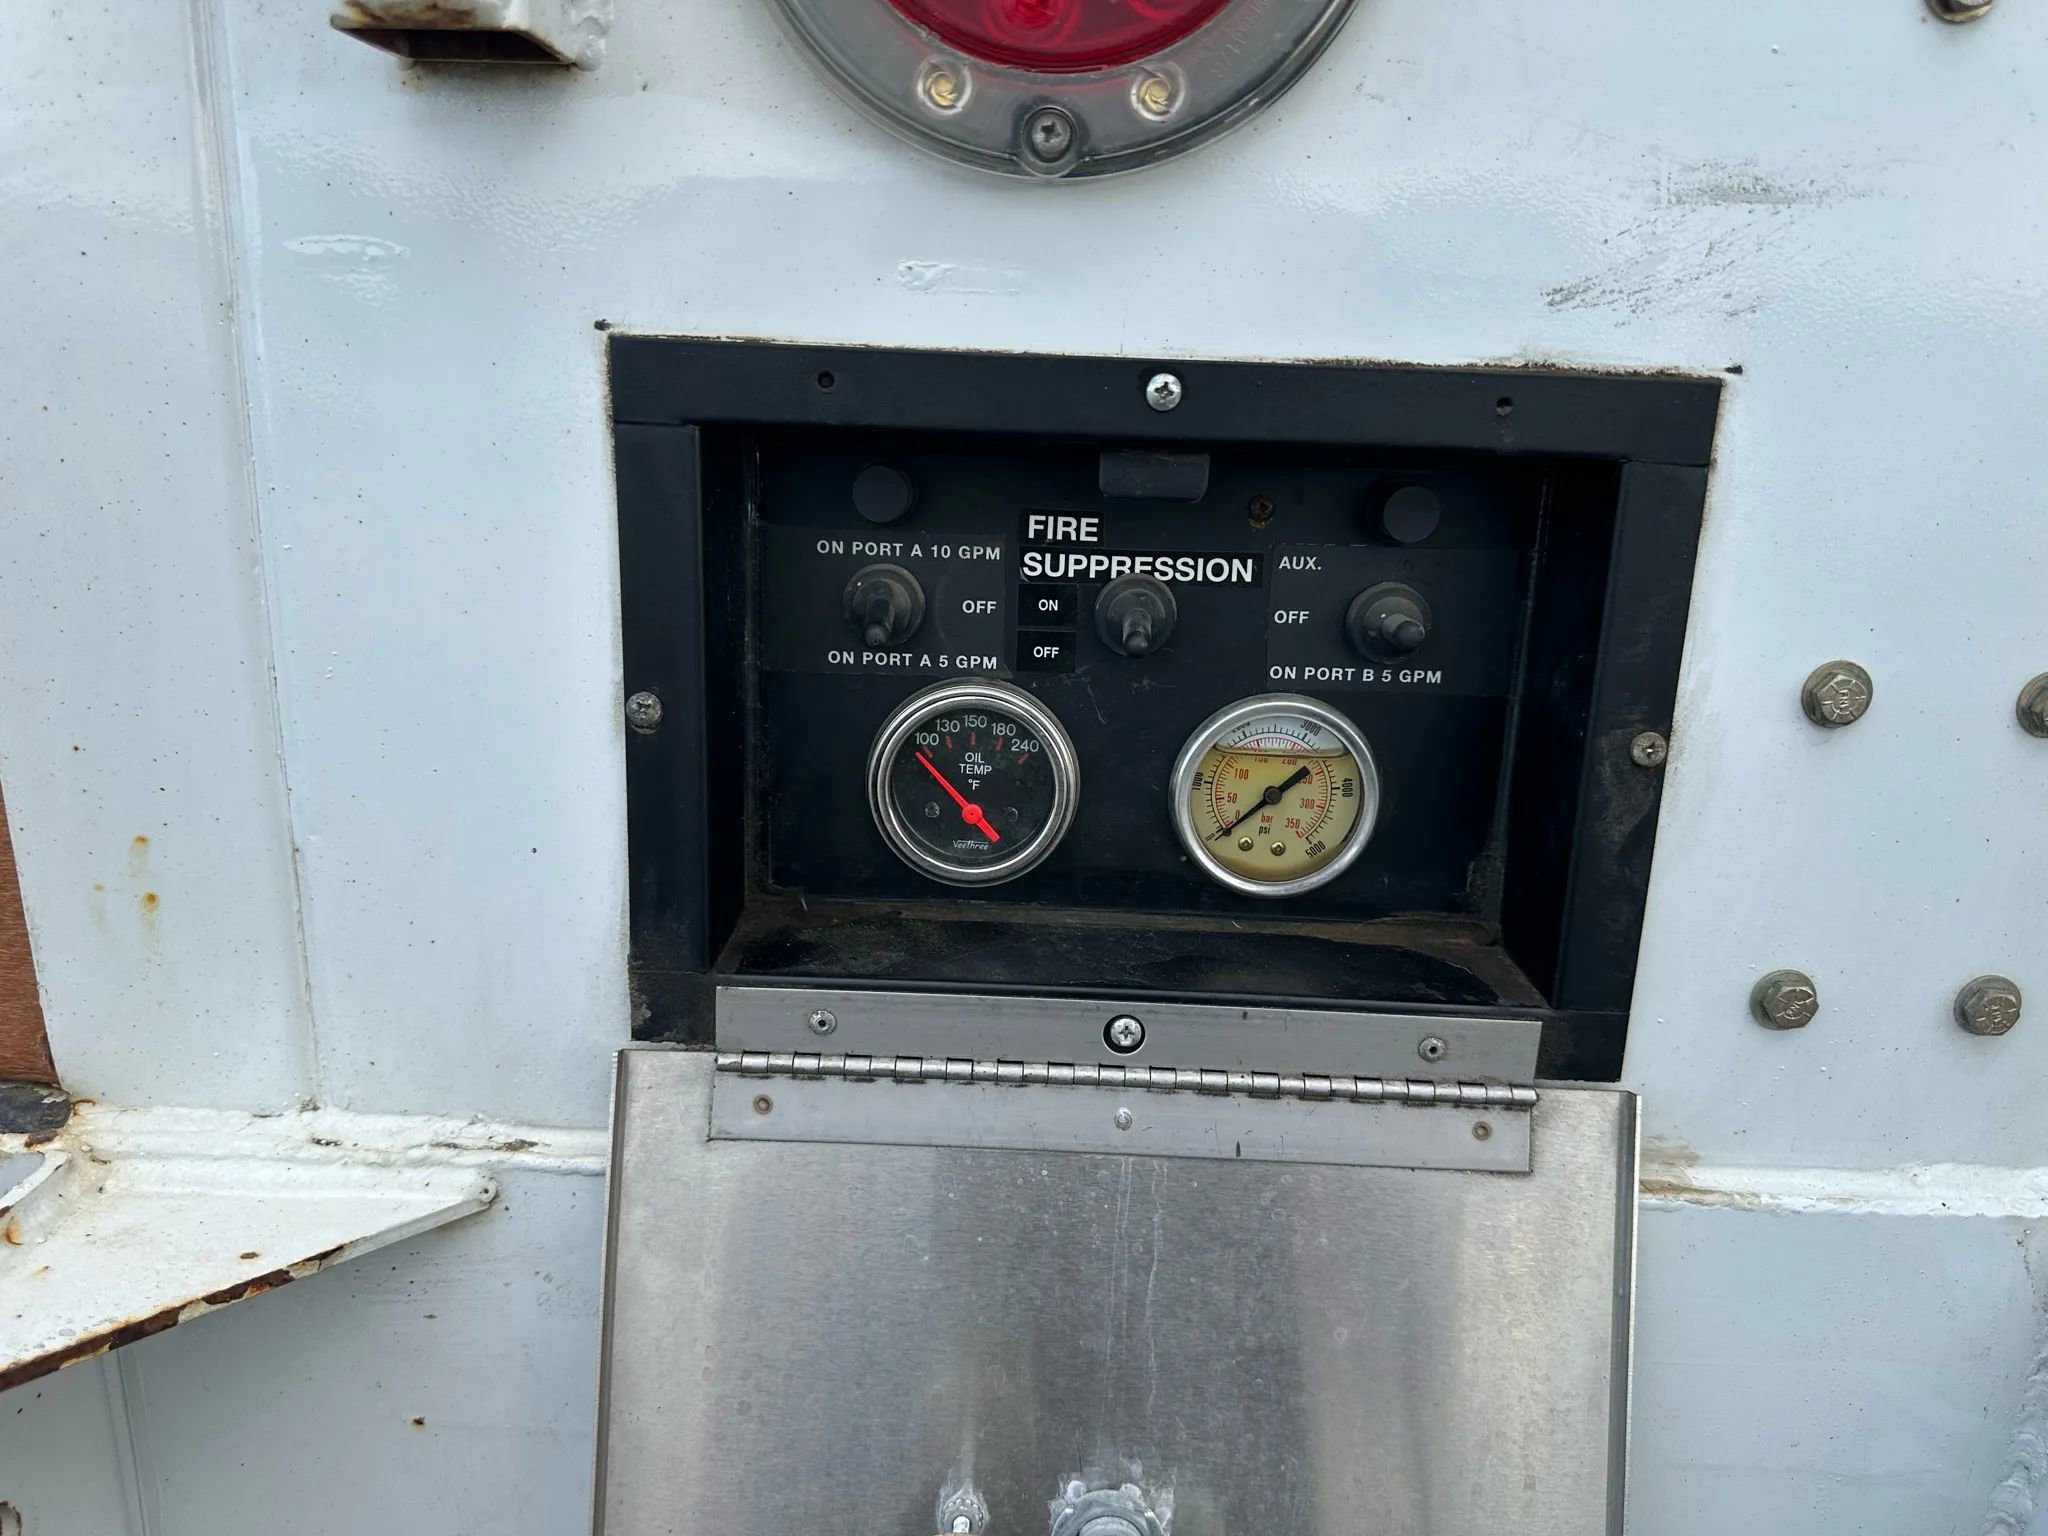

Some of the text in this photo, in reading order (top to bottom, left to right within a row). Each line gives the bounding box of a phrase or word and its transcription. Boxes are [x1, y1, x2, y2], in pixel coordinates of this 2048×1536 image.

[1028, 514, 1099, 542] FIRE
[816, 539, 1001, 560] ON PORT A 10 GPM
[1022, 551, 1254, 583] SUPPRESSION
[1278, 555, 1322, 570] AUX.
[962, 600, 997, 615] OFF
[1038, 599, 1059, 611] ON
[1273, 610, 1310, 624] OFF
[1033, 646, 1060, 659] OFF
[827, 650, 997, 670] ON PORT A 5 GPM
[1269, 665, 1442, 684] ON PORT B 5 GPM
[915, 714, 1040, 753] 100 130 150 180 240
[1300, 719, 1322, 737] 3000
[964, 752, 985, 763] OIL
[958, 763, 992, 776] TEMP
[1234, 768, 1249, 780] 100
[1341, 777, 1354, 798] 4000
[1226, 792, 1238, 803] 50
[1299, 798, 1315, 809] 300
[1260, 812, 1274, 824] bar
[1284, 817, 1301, 829] 350
[1258, 824, 1271, 836] psi
[1304, 840, 1326, 858] 5000
